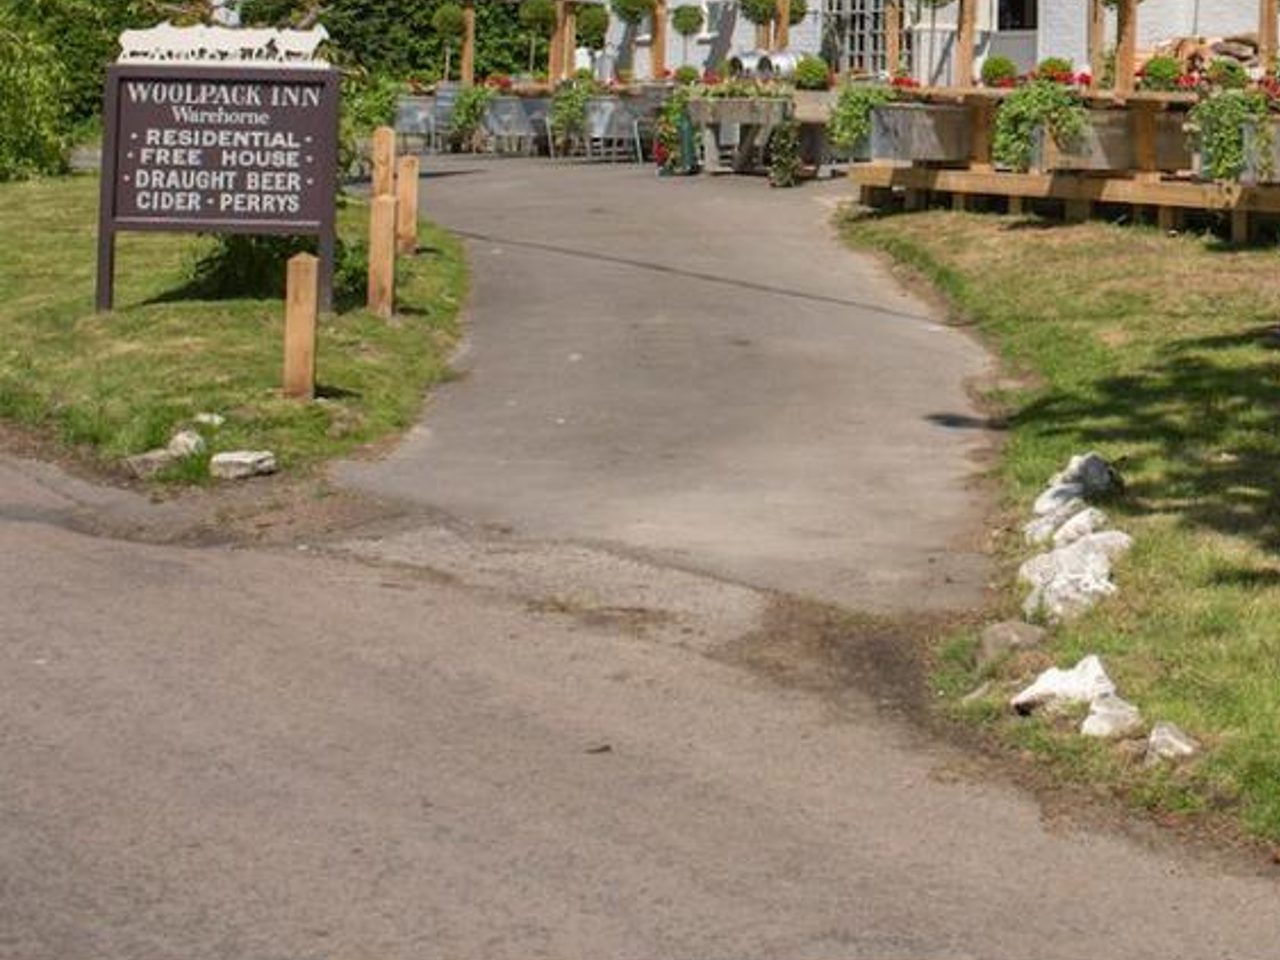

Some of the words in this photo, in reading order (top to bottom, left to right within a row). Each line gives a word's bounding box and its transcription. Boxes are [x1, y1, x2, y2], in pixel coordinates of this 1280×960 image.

[127, 82, 262, 106] WOOLPACK
[270, 86, 321, 107] INN
[171, 105, 270, 125] Warehorne
[146, 129, 302, 149] RESIDENTIAL
[140, 148, 202, 166] FREE
[221, 150, 300, 168] HOUSE
[135, 169, 237, 189] DRAUGHT
[246, 171, 301, 191] BEER
[136, 191, 201, 210] CIDER
[219, 193, 301, 212] PERRYS
